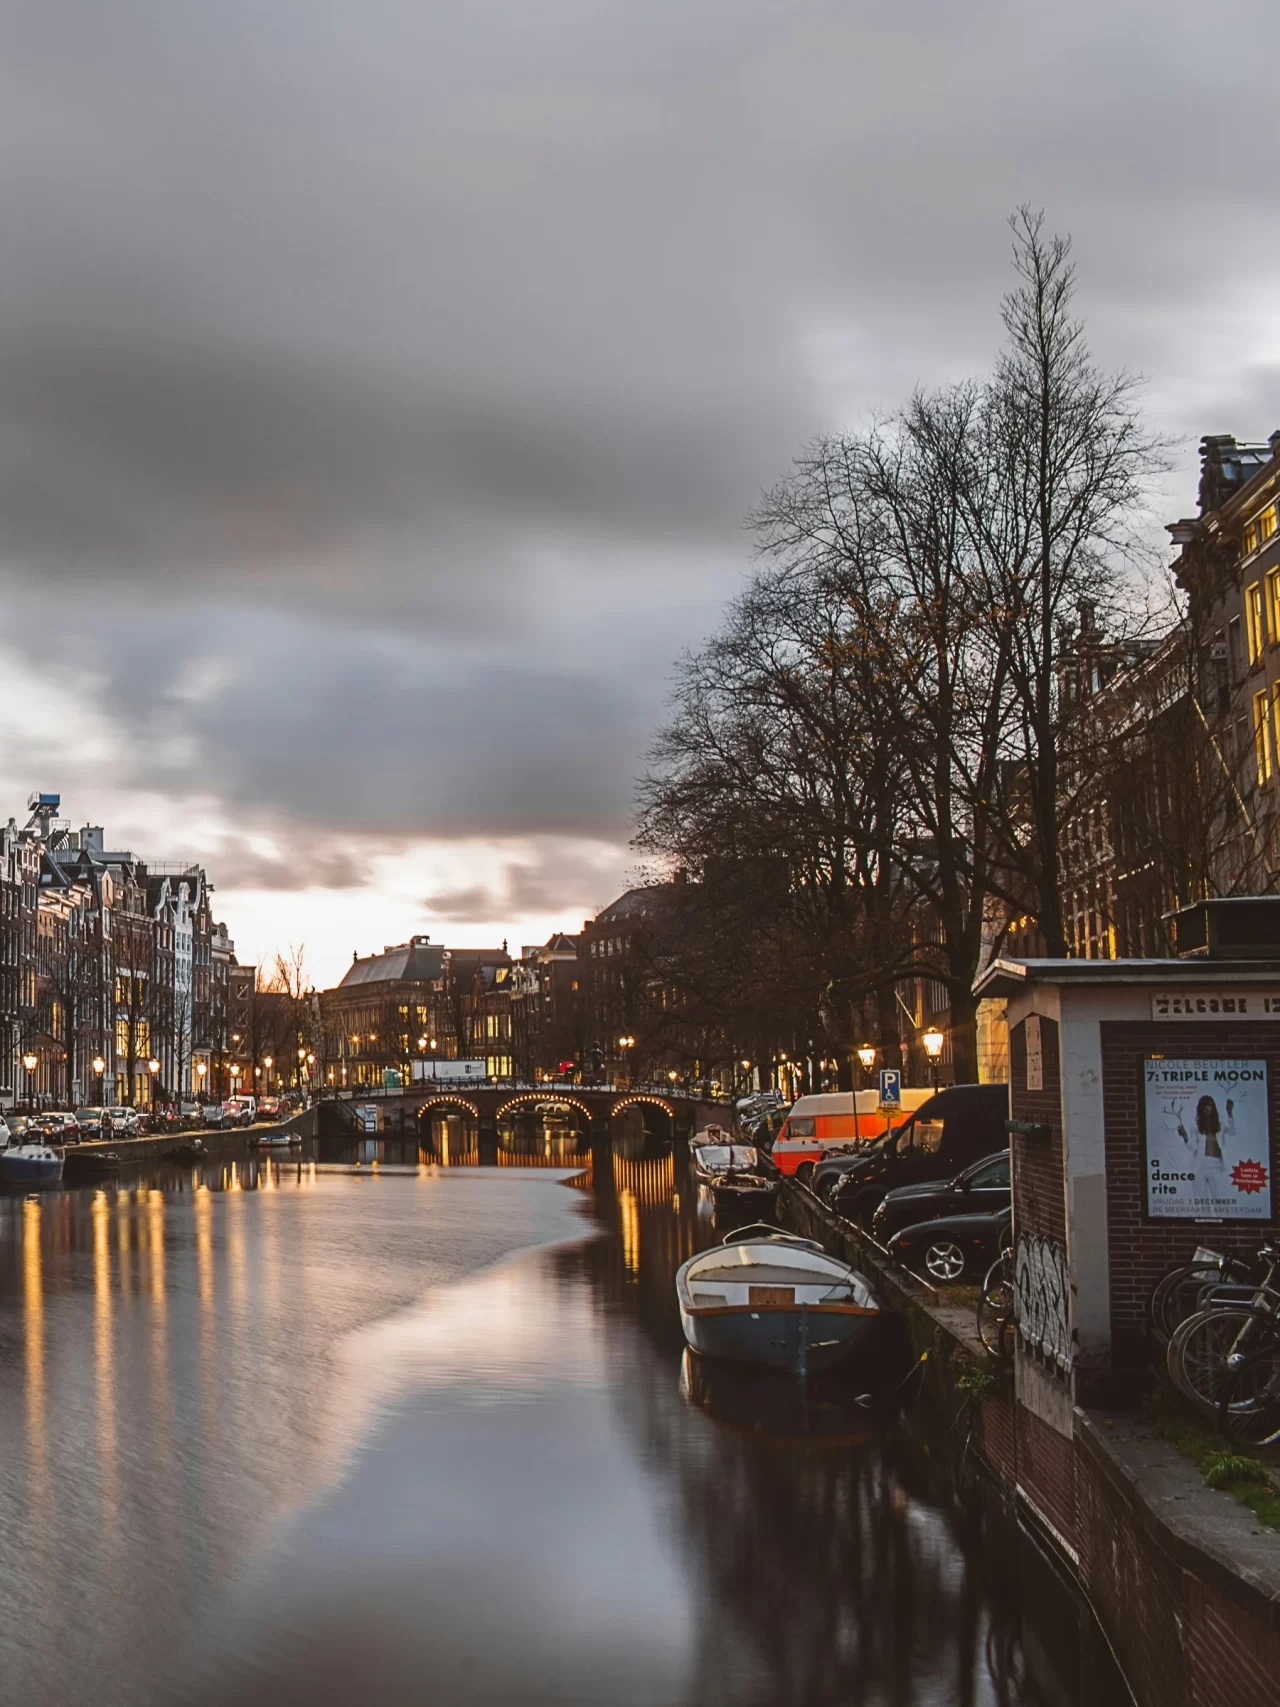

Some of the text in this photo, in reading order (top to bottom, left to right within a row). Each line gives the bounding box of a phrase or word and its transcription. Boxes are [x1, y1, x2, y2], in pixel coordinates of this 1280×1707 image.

[1146, 1060, 1249, 1069] NICOLE BEUTLER
[885, 1073, 896, 1089] P
[1147, 1070, 1264, 1081] 7: TRIPLE MOON
[1150, 1159, 1160, 1168] a
[1151, 1170, 1196, 1181] dance
[1152, 1183, 1177, 1195] rite
